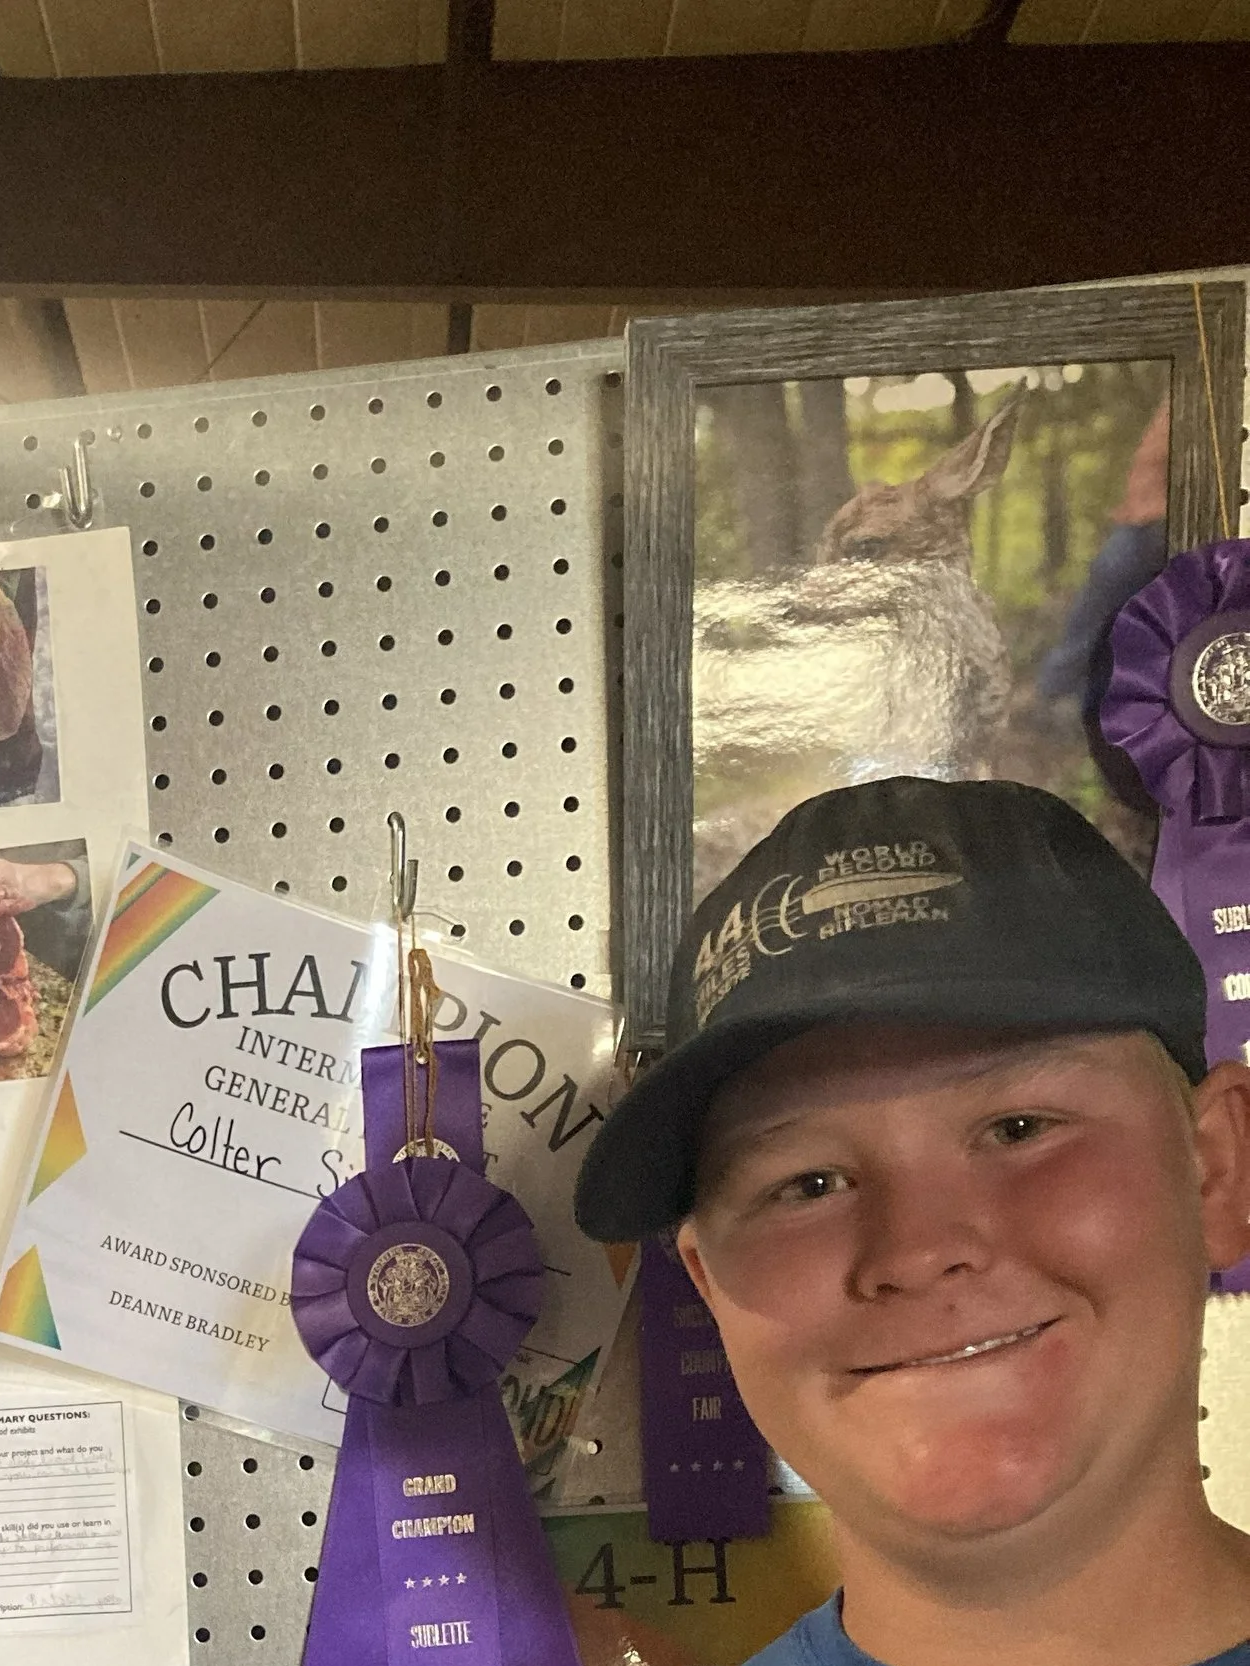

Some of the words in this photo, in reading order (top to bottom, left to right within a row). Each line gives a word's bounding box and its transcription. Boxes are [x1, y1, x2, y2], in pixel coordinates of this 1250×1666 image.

[818, 852, 937, 881] RECORD
[822, 841, 928, 866] WORLD
[833, 896, 931, 922] NOMAD
[819, 908, 949, 940] RIFLEMAN
[204, 1065, 351, 1135] GENERAL
[169, 1101, 282, 1180] Colter
[99, 1234, 168, 1267] AWARD
[168, 1256, 277, 1302] SPONSORED
[279, 1291, 293, 1307] B
[108, 1290, 184, 1326] DEANNE
[184, 1314, 270, 1352] BRADLEY
[27, 1410, 91, 1424] QUESTIONS:
[11, 1449, 39, 1460] project
[39, 1446, 55, 1456] and
[55, 1445, 75, 1454] what
[76, 1444, 88, 1454] do
[88, 1445, 104, 1455] you
[402, 1473, 457, 1498] GRAND
[1, 1522, 26, 1533] skill(s)
[26, 1522, 40, 1531] did
[40, 1523, 55, 1532] you
[56, 1521, 70, 1529] use
[82, 1519, 103, 1528] learn
[391, 1513, 475, 1540] CHAMPION
[576, 1538, 737, 1610] 4-H
[410, 1620, 474, 1649] SUBLETTE
